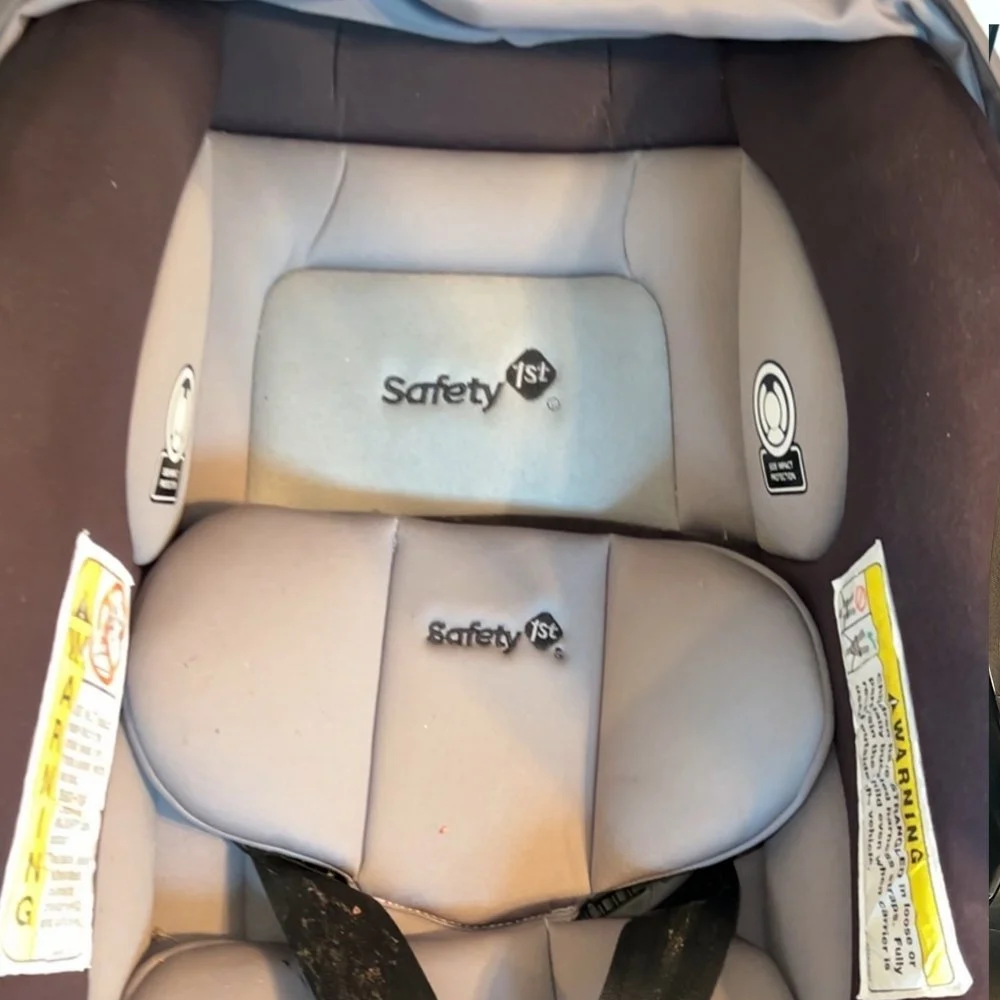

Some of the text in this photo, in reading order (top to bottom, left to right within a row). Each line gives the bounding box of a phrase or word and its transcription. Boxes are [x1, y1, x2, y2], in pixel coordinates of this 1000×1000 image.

[381, 359, 552, 413] Safety 1st
[426, 617, 560, 654] Safety 1st
[894, 718, 924, 864] WARNING
[898, 884, 907, 898] in
[878, 901, 890, 952] carrier
[884, 958, 891, 970] is
[903, 903, 914, 946] loose
[894, 937, 905, 975] Fully
[908, 951, 917, 967] or
